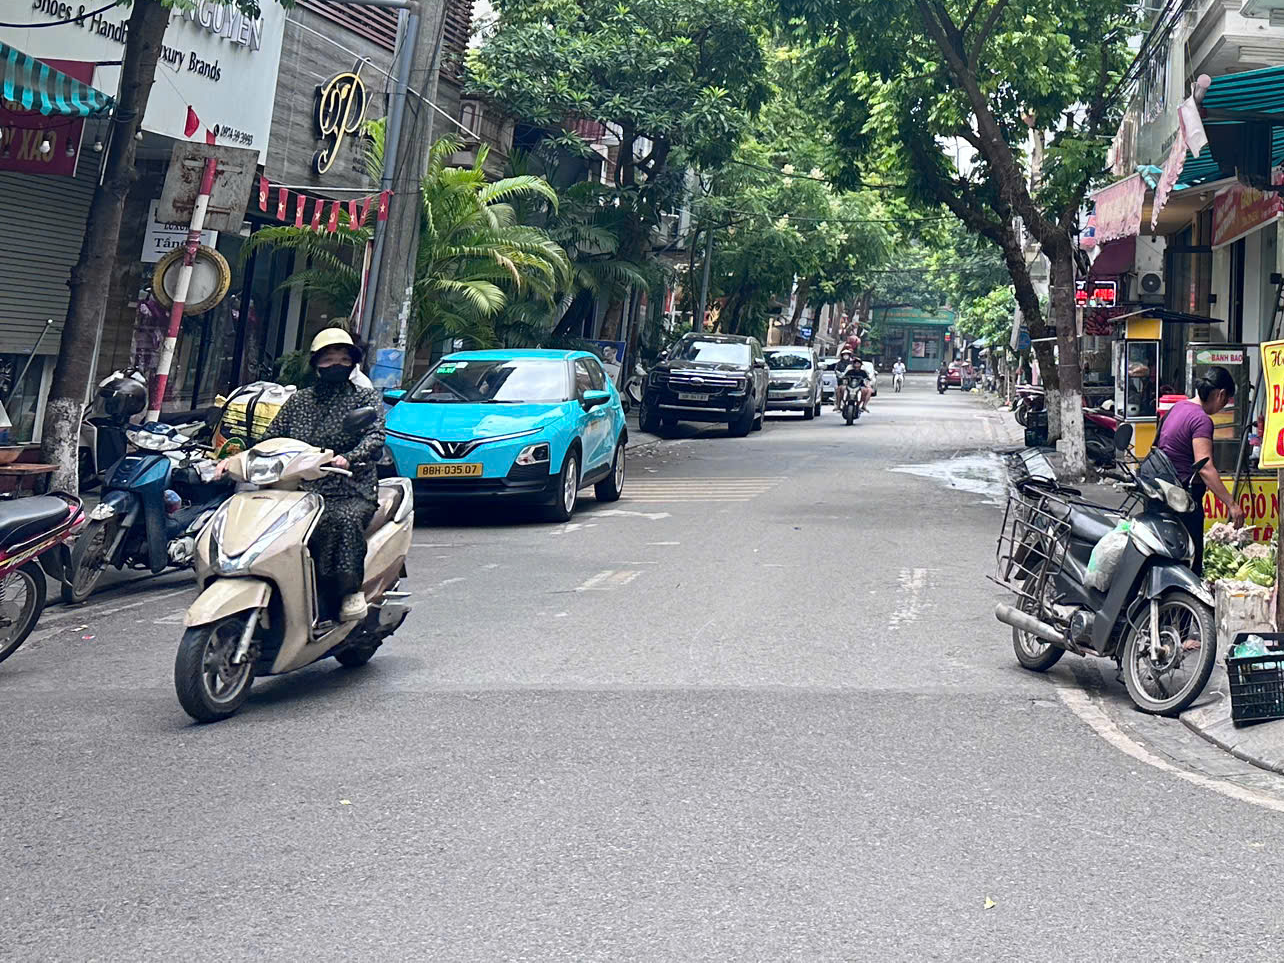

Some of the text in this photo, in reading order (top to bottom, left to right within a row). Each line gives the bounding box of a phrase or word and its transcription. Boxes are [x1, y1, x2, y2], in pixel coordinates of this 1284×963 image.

[77, 4, 87, 28] &
[187, 50, 221, 82] Brands
[1240, 485, 1267, 519] GIÒ
